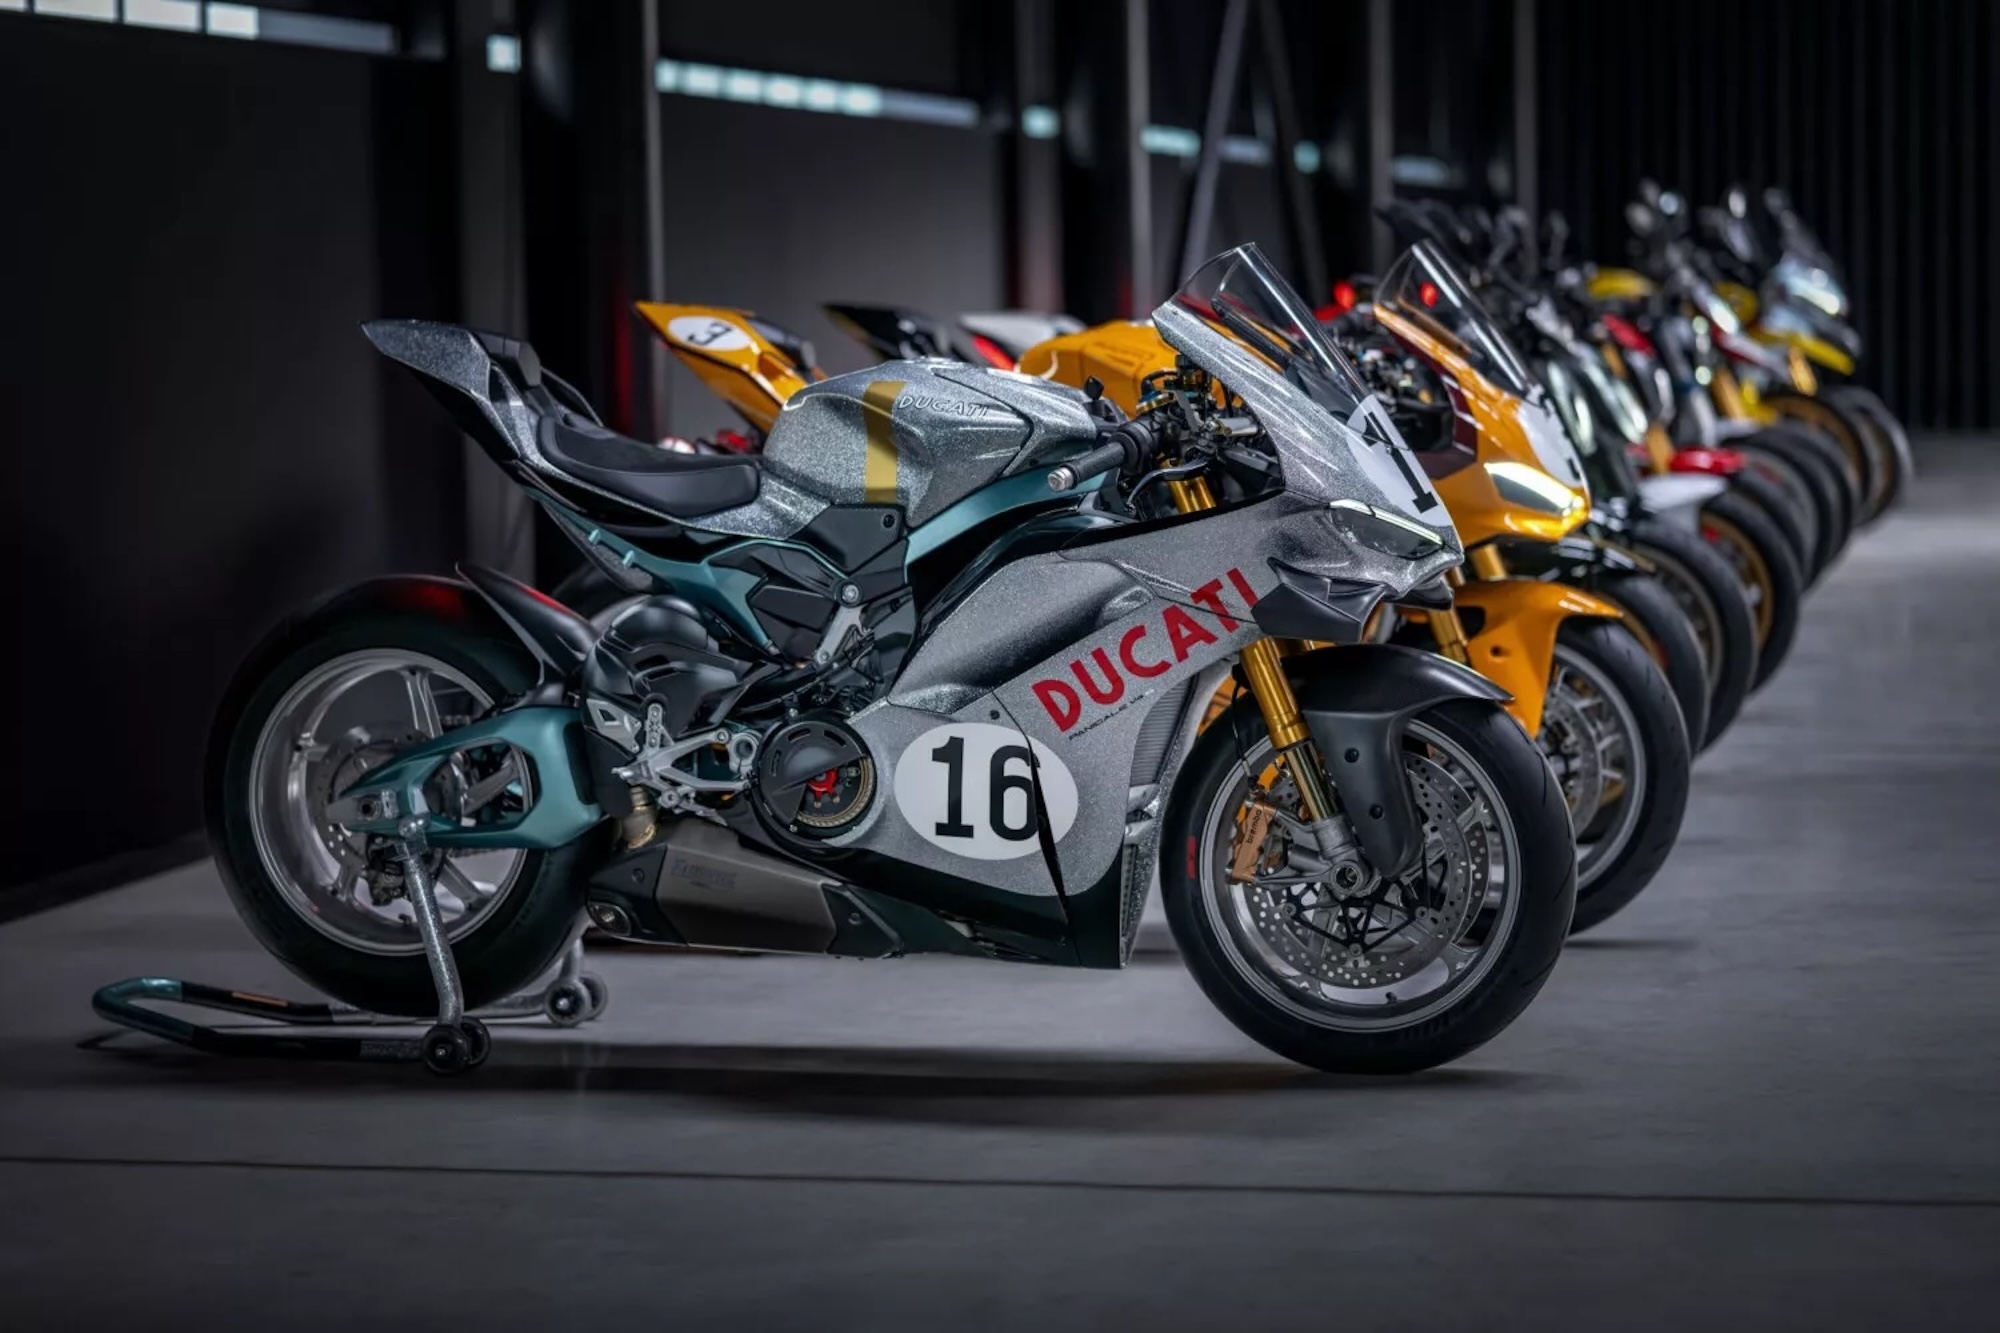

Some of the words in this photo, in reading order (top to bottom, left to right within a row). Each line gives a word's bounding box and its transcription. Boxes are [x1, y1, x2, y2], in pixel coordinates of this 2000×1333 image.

[688, 321, 733, 346] 3
[898, 395, 989, 417] DUCATI
[1031, 567, 1259, 733] DUCATI
[932, 736, 1041, 841] 16
[1246, 809, 1262, 844] brembo
